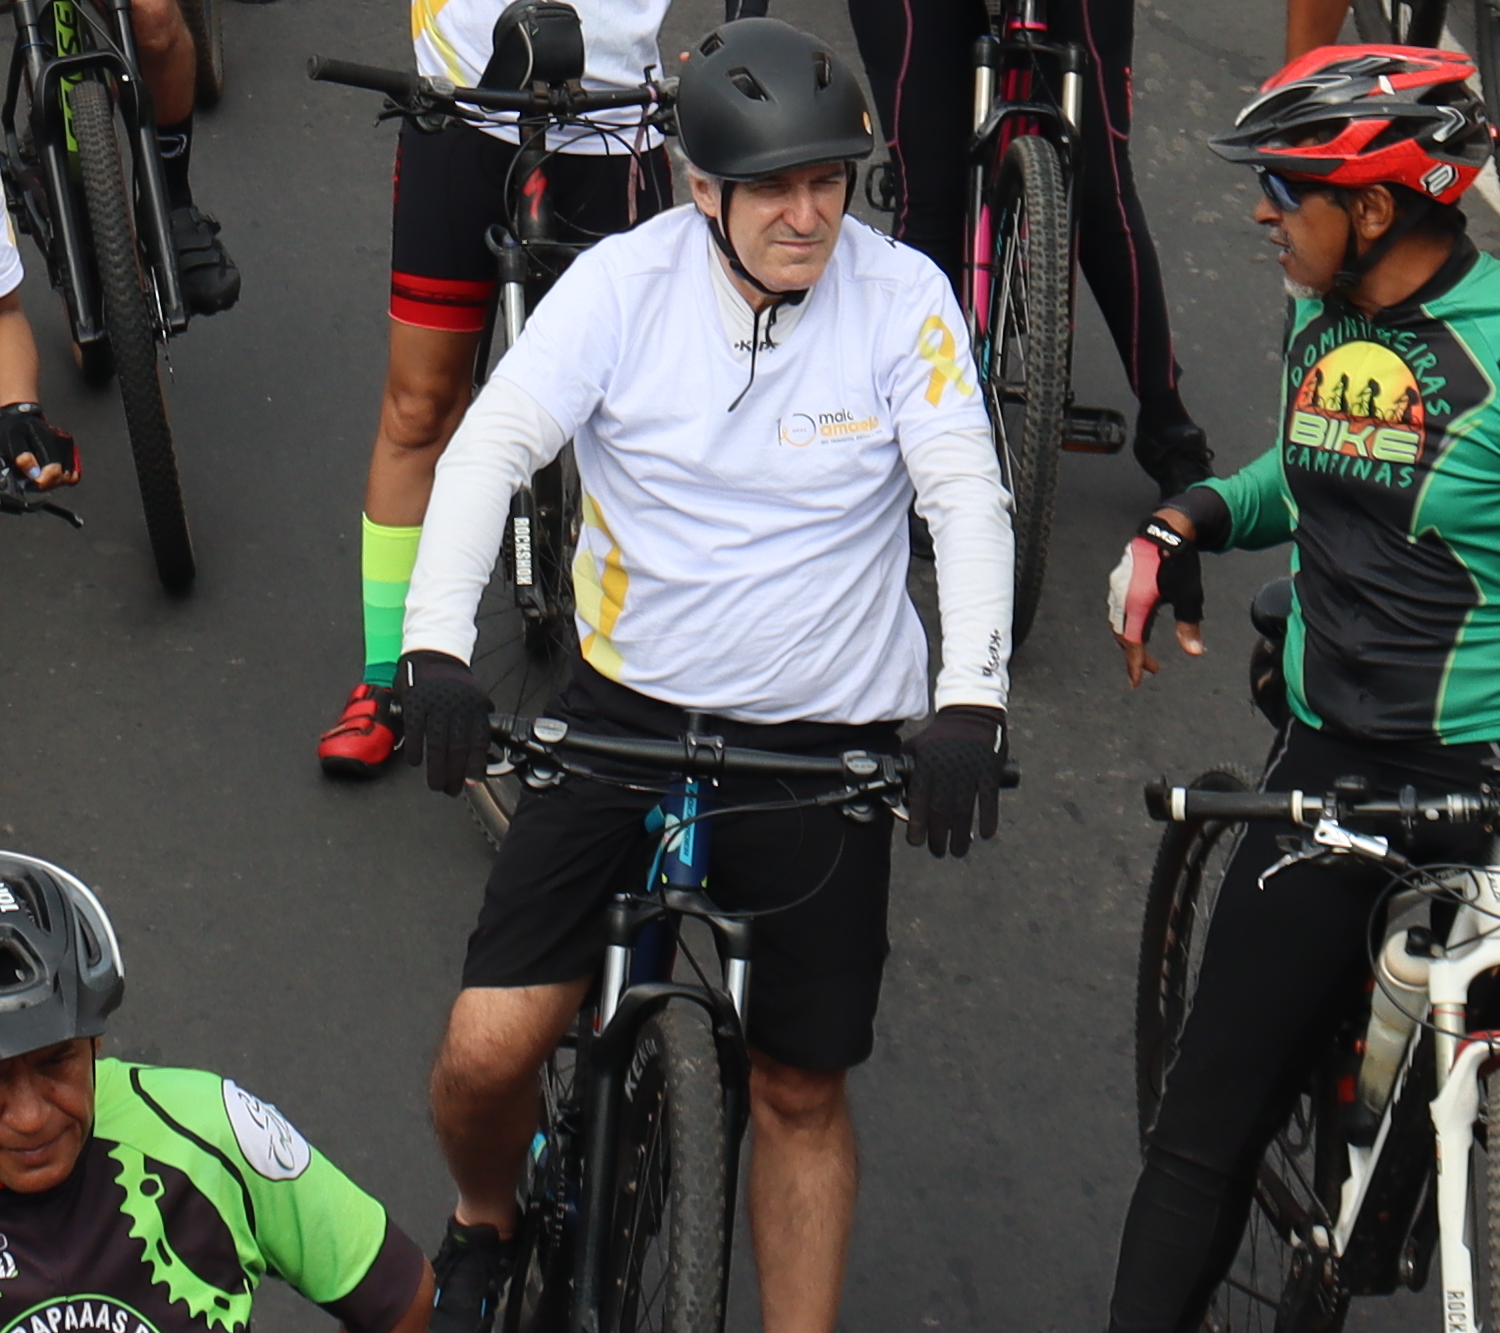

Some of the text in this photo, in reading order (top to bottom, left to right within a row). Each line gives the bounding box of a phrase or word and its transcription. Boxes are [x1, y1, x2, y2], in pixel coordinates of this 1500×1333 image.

[1287, 411, 1422, 466] BIKE
[1282, 444, 1416, 489] CAMPINAS
[514, 517, 533, 586] ROCKSHOX
